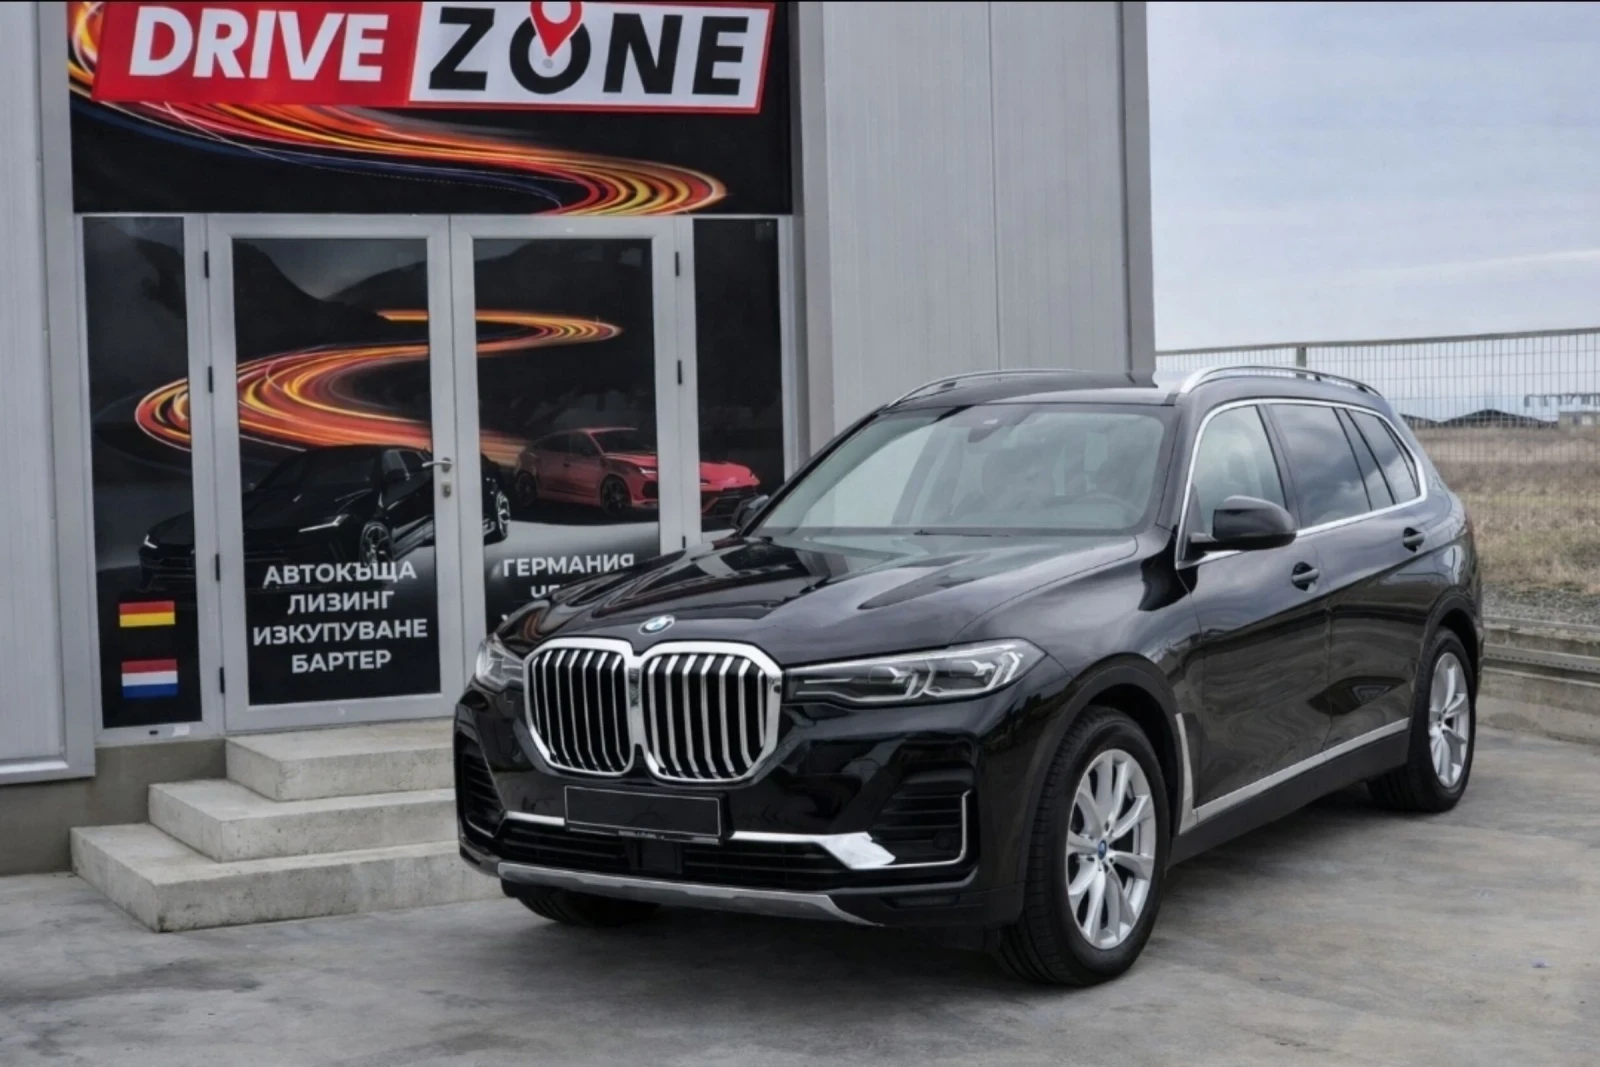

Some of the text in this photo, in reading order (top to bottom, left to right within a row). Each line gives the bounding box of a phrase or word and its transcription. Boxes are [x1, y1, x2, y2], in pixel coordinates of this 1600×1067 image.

[129, 6, 749, 96] DRIVE ZONE
[263, 561, 417, 587] АВТОКЪЩА
[287, 591, 395, 615] ЛИЗИНГ
[252, 618, 428, 646] ИЗКУПУВАНЕ
[291, 650, 392, 674] БАРТЕР
